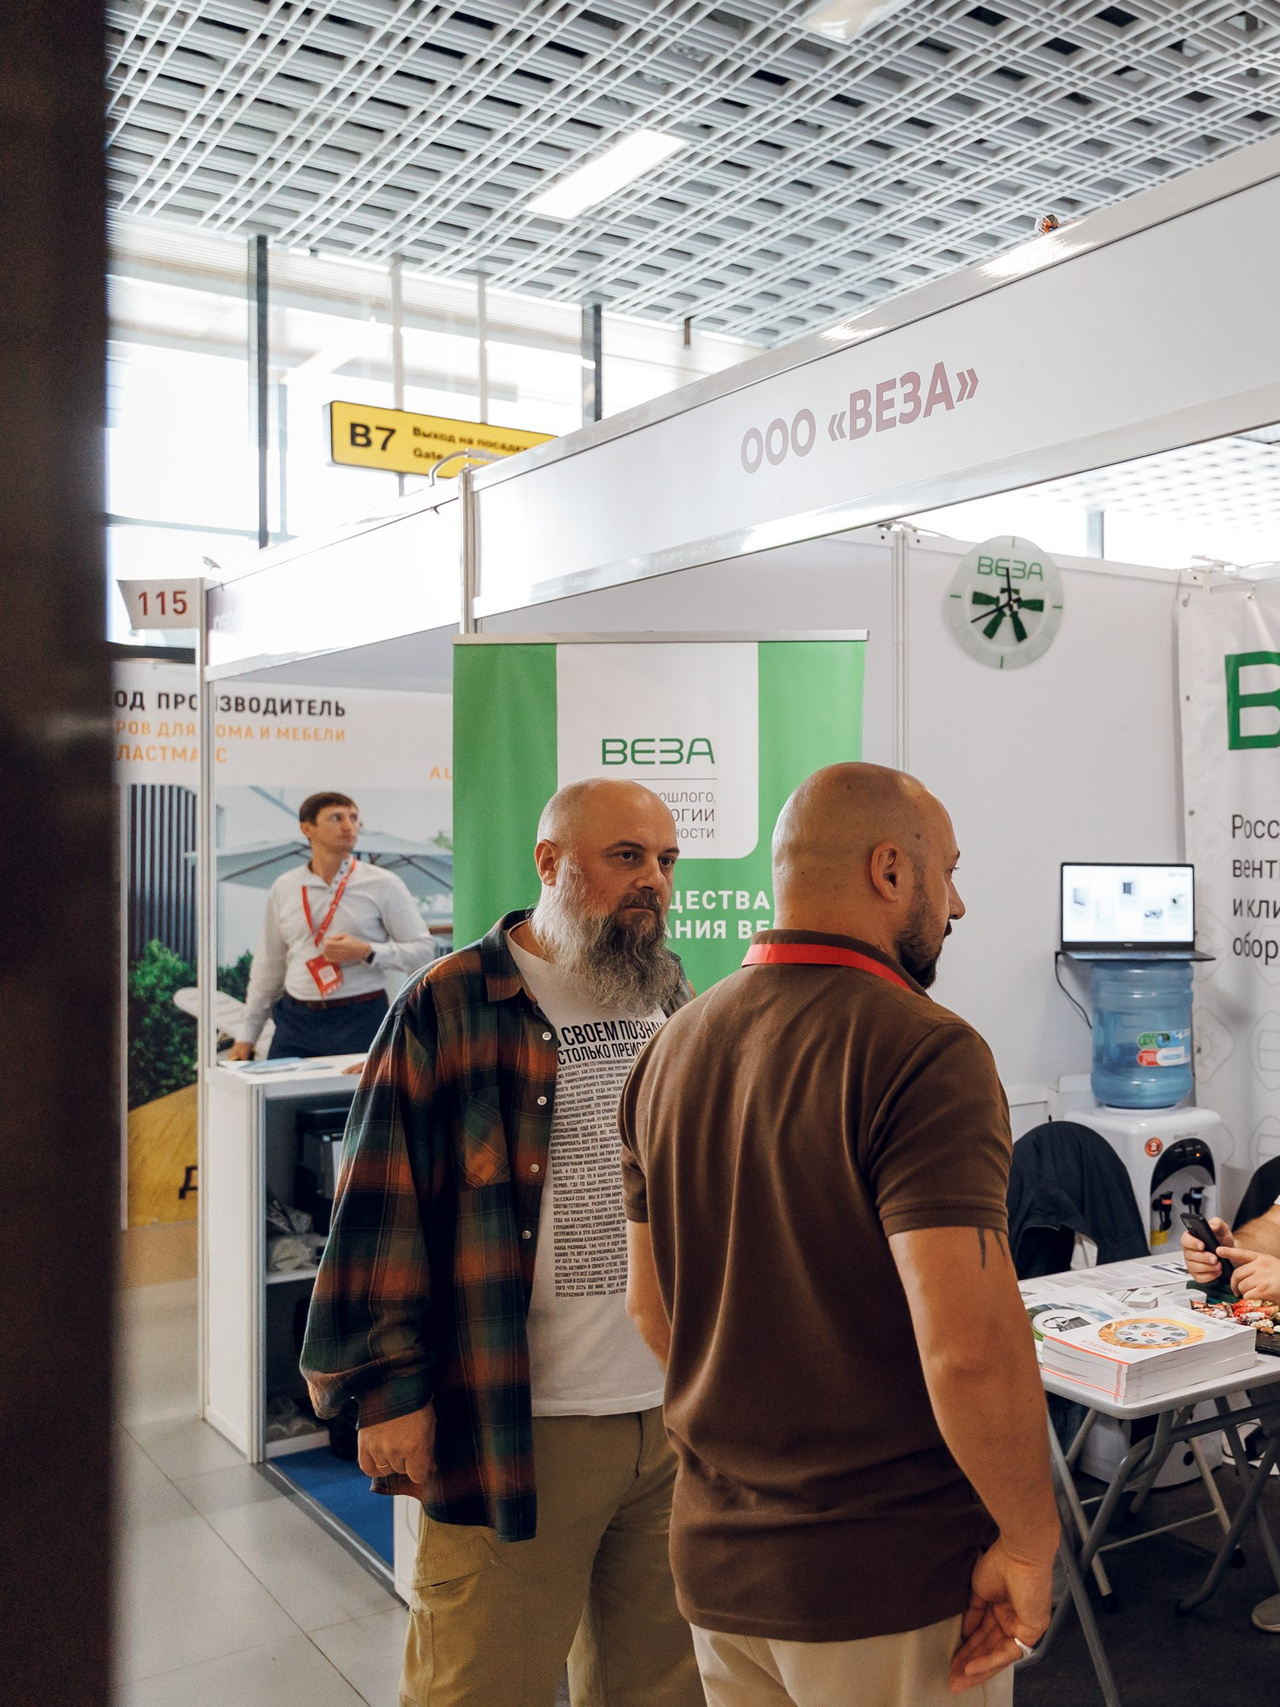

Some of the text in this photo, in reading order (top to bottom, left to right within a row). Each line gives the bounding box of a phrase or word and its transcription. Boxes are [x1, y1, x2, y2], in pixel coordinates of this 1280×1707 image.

[741, 361, 979, 474] ООО «ВЕЗА»
[350, 423, 396, 451] B7
[477, 440, 530, 452] посадк
[413, 447, 443, 460] Gate
[138, 590, 187, 616] 115
[157, 722, 196, 738] ДЛЯ
[215, 724, 254, 740] ОМА
[260, 726, 270, 739] И
[277, 726, 346, 742] МЕБЕЛИ
[601, 737, 715, 765] ВЕЗА
[561, 1020, 619, 1046] СВОЕМ
